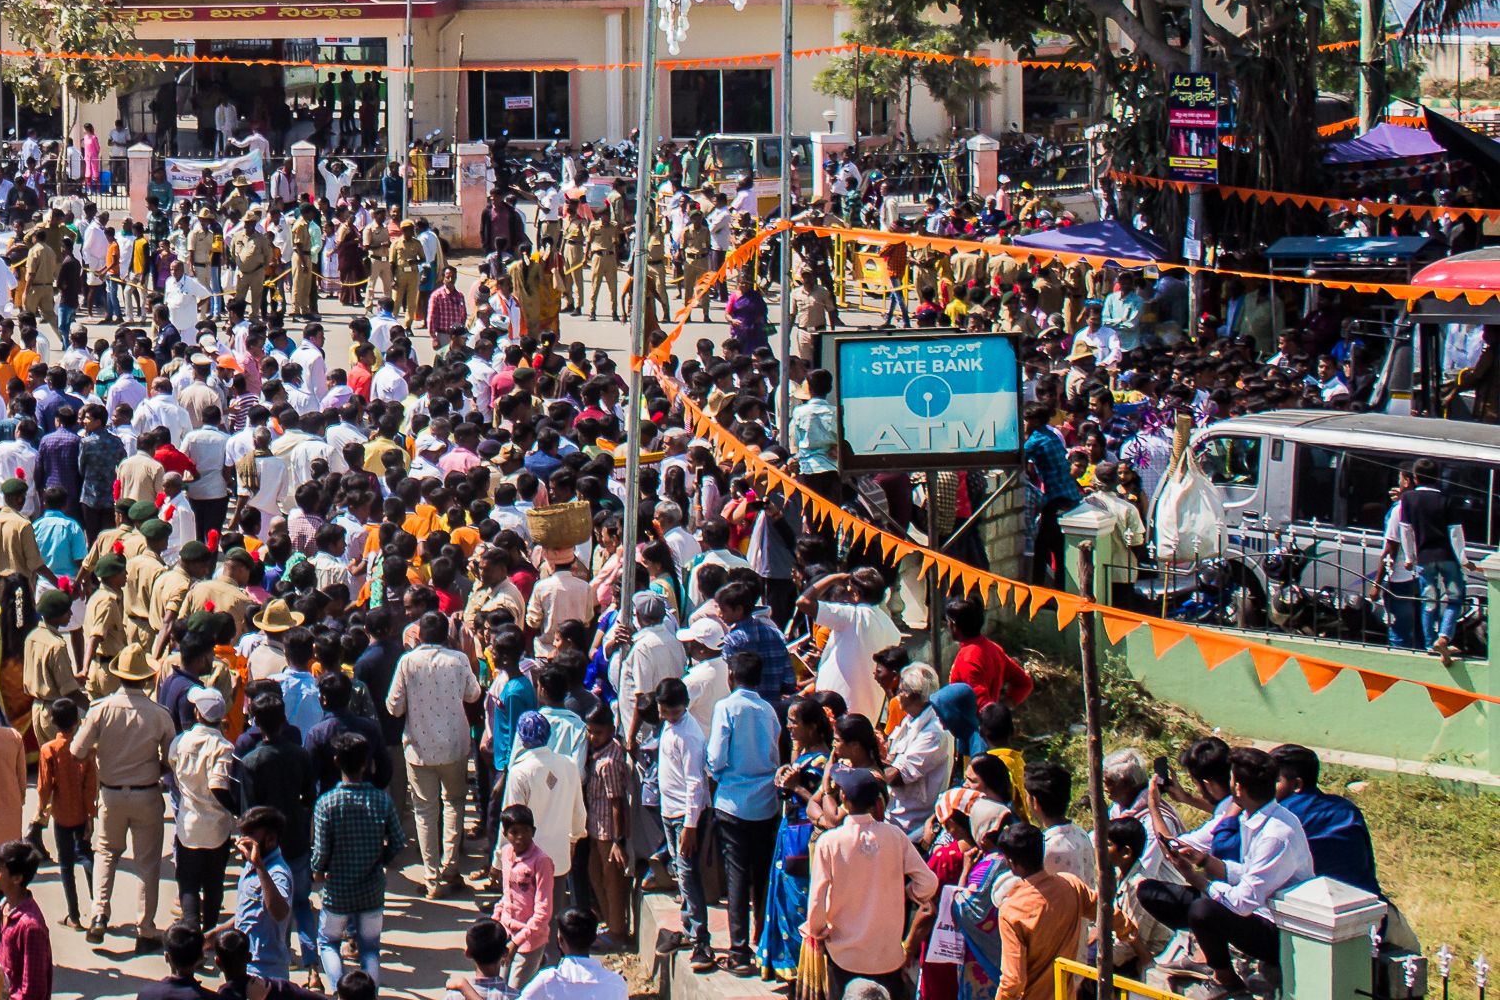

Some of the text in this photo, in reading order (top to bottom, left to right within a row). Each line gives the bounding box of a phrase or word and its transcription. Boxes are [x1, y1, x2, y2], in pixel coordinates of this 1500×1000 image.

[209, 6, 266, 19] ಬಸ್
[871, 357, 983, 375] STATE BANK
[865, 421, 996, 451] ATM
